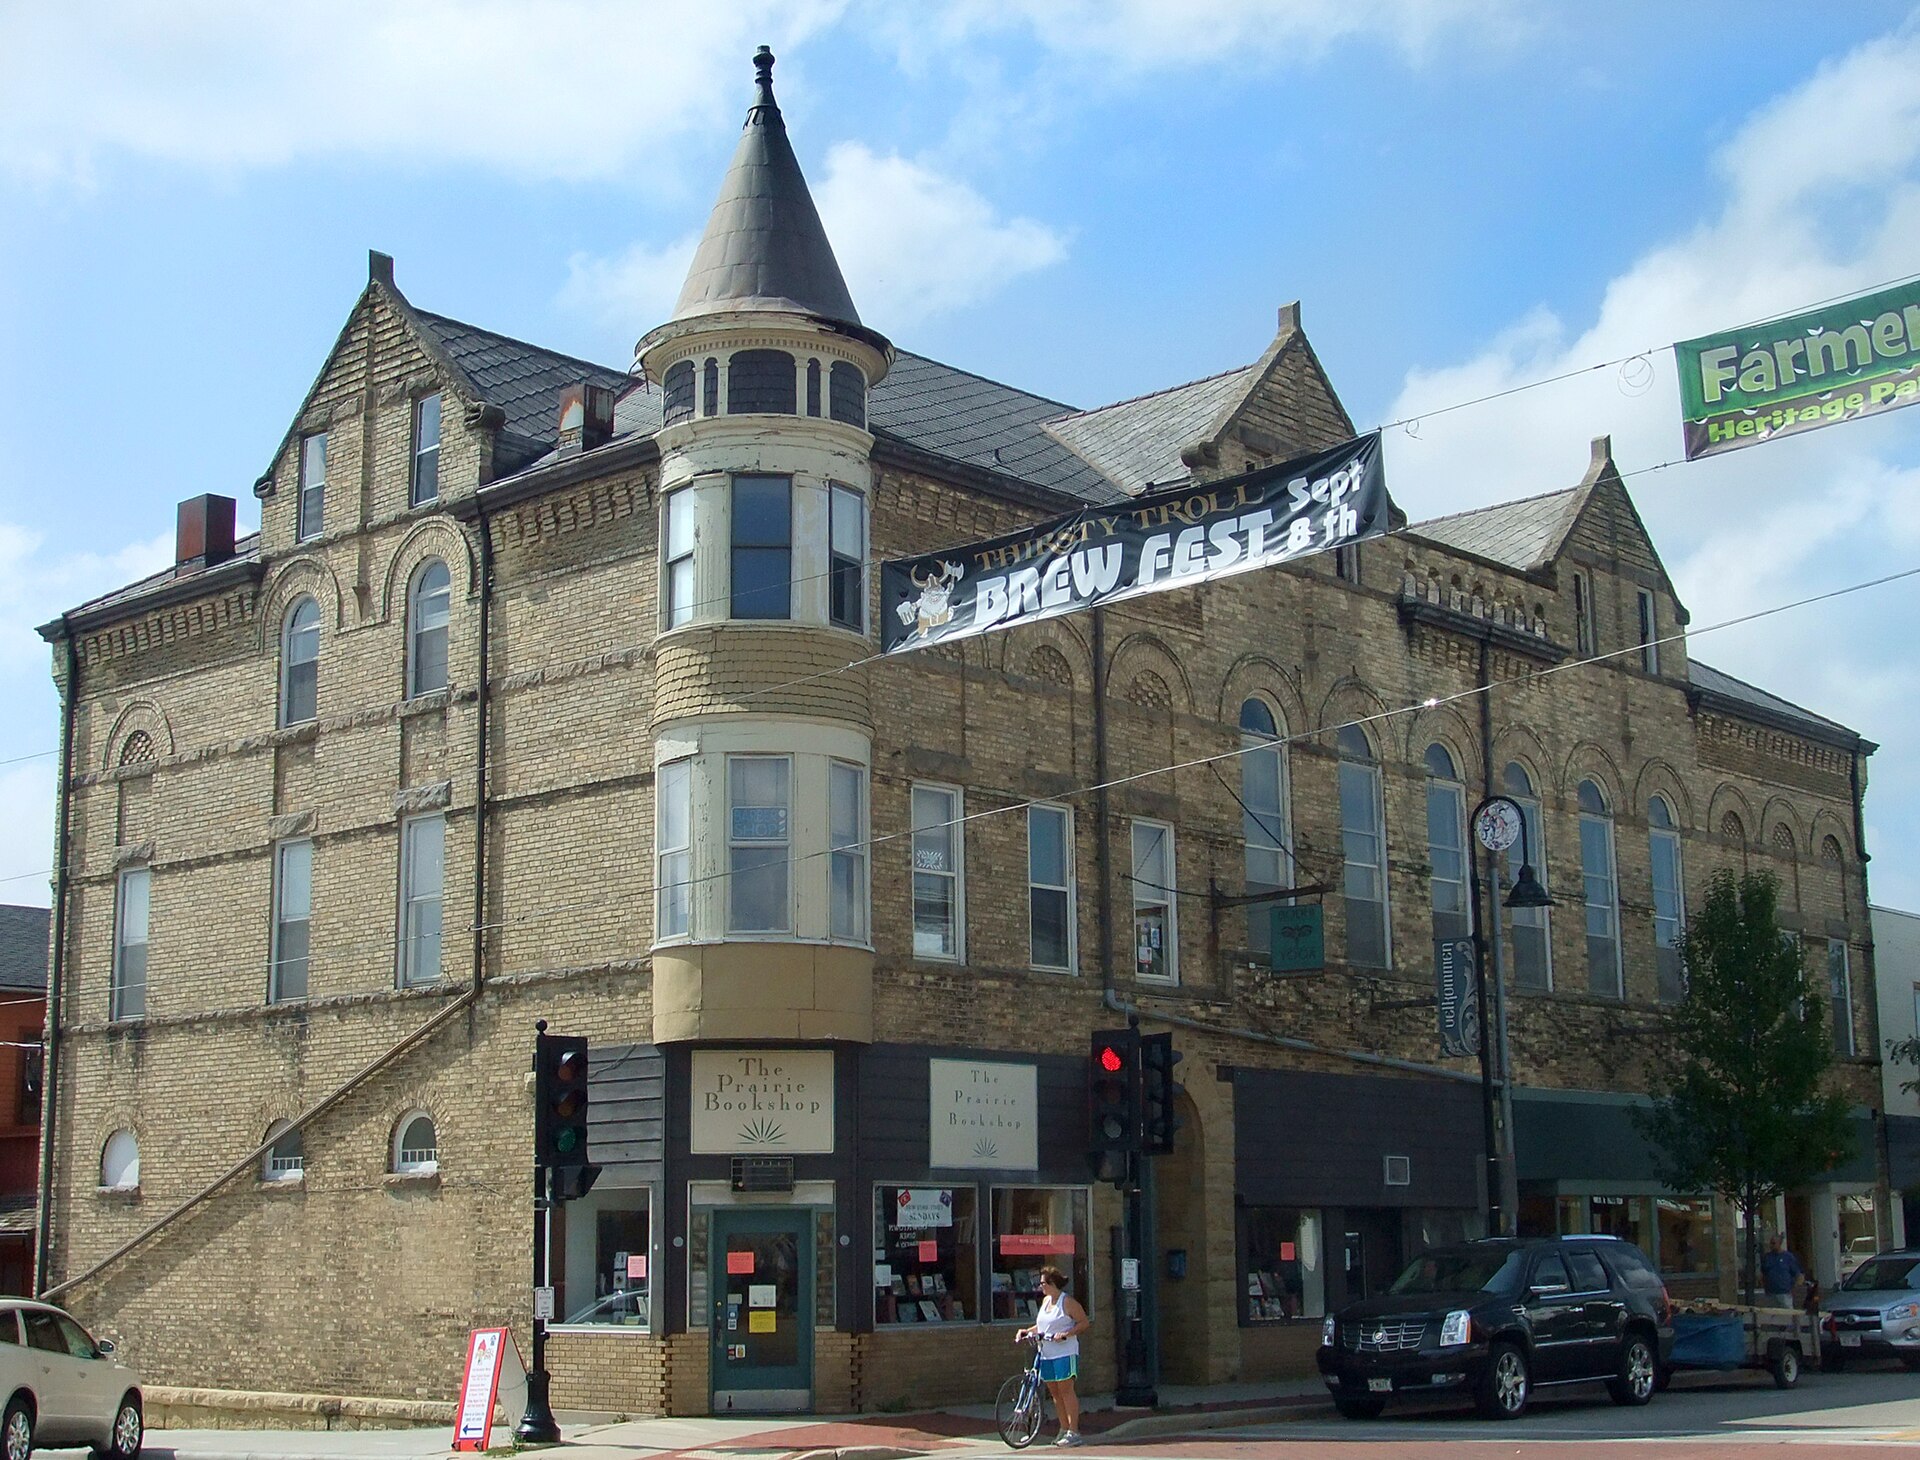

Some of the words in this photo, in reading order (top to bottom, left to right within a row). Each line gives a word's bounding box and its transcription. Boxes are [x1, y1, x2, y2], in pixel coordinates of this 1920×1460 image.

[1708, 391, 1865, 444] Heritage
[1870, 374, 1920, 405] Pa
[1287, 459, 1364, 512] Sept
[1132, 485, 1265, 530] TROLL
[974, 542, 1123, 625] BREW
[1138, 508, 1274, 586] FEST
[734, 823, 778, 837] SHOP
[738, 1057, 783, 1076] The
[716, 1074, 805, 1093] Prairie
[970, 1069, 998, 1084] The
[704, 1092, 820, 1114] Bookshop
[954, 1089, 1016, 1106] Prairie
[949, 1112, 1021, 1130] Bookshop
